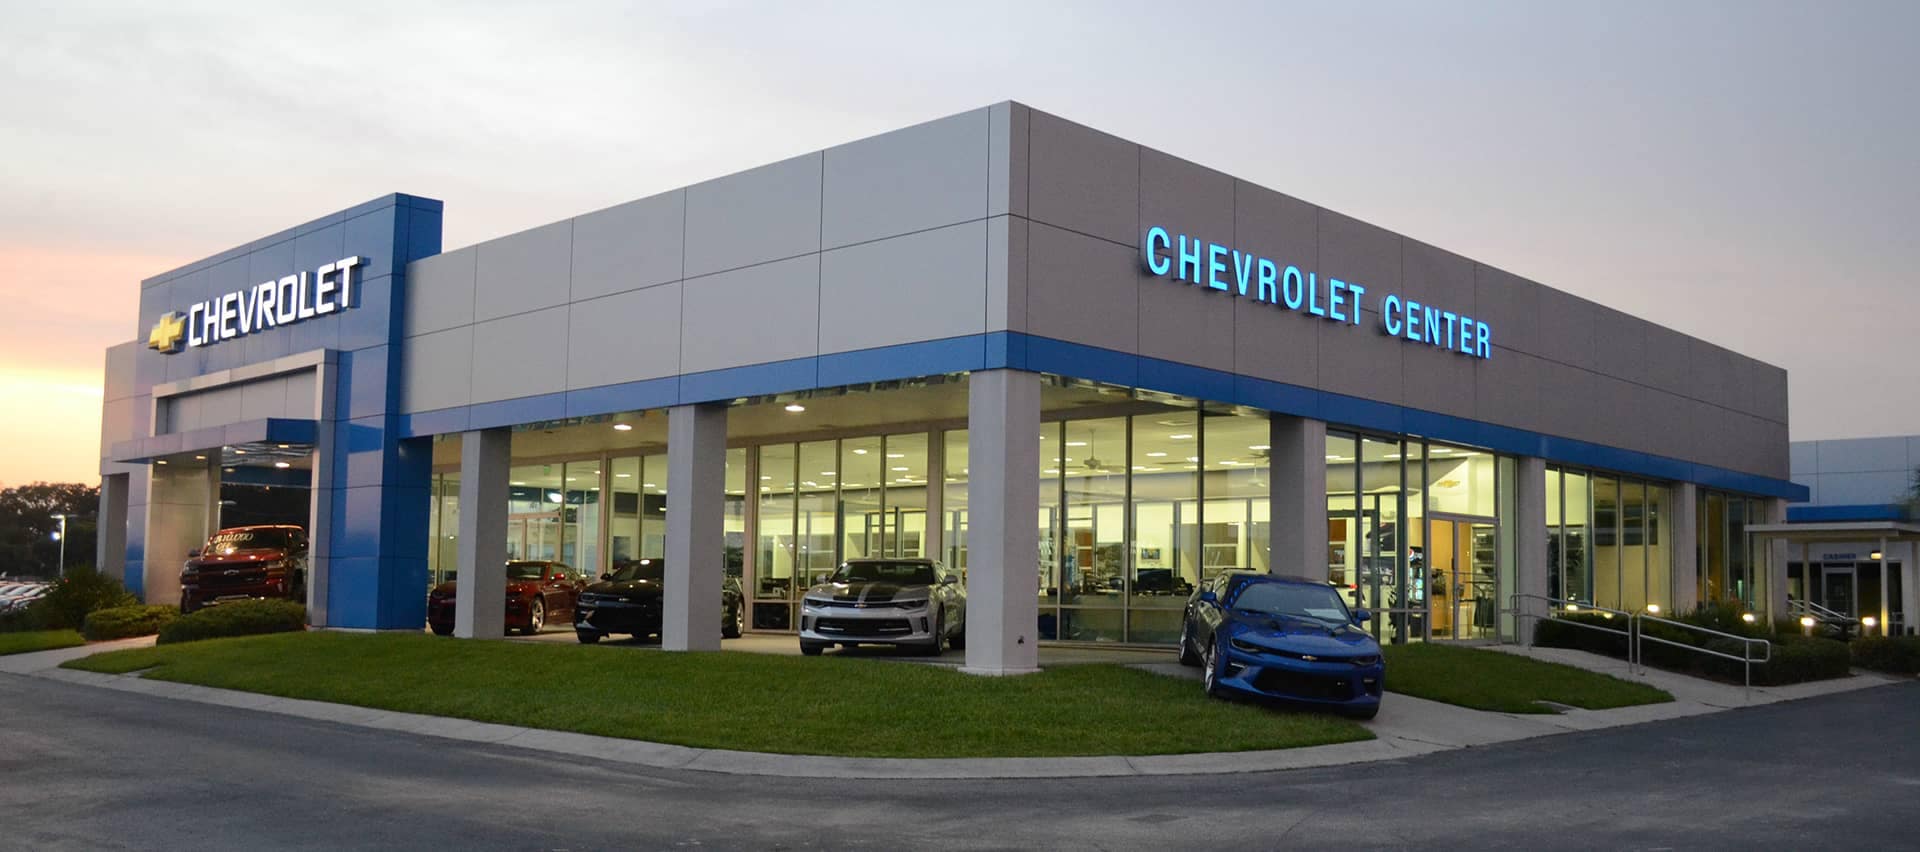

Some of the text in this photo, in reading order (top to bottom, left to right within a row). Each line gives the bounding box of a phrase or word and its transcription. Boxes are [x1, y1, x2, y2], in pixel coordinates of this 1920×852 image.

[188, 256, 360, 347] CHEVROLET
[1146, 226, 1492, 360] CHEVROLET CENTER
